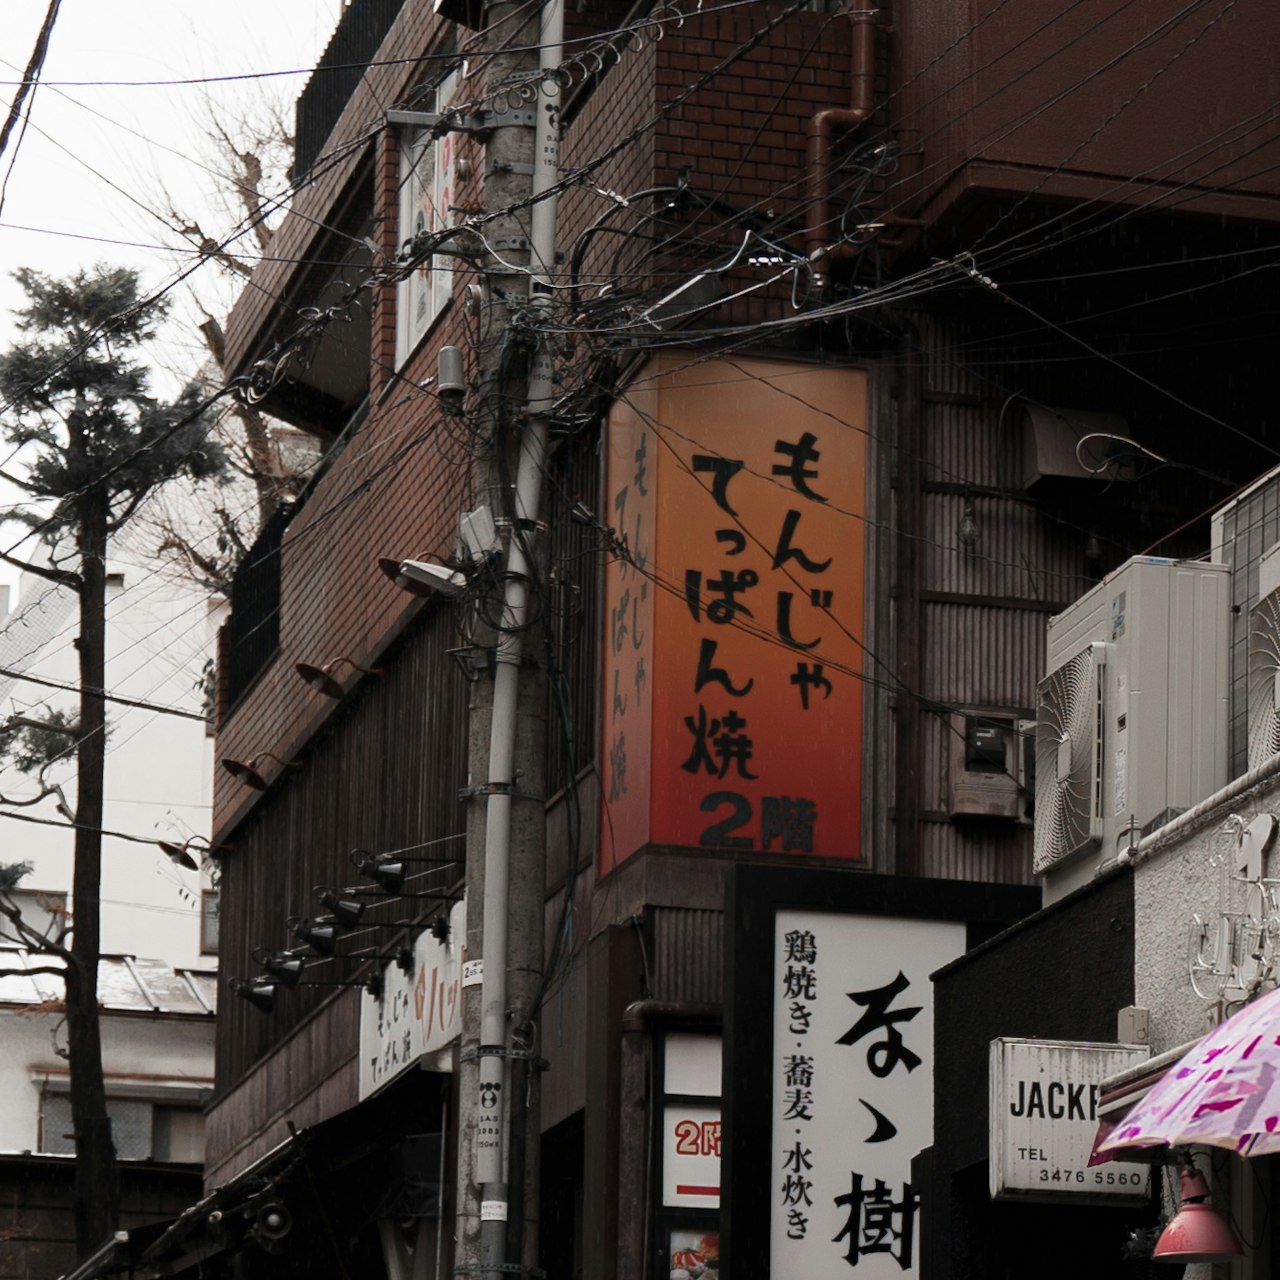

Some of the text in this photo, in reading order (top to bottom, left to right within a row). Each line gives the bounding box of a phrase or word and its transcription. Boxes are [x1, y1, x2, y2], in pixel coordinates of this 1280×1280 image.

[632, 431, 648, 706] もんじゃ
[682, 454, 759, 781] てっぱん焼
[772, 431, 833, 710] もんじゃ
[699, 790, 818, 853] 2階
[1018, 1148, 1048, 1161] TEL
[1040, 1170, 1141, 1186] 3476 5560
